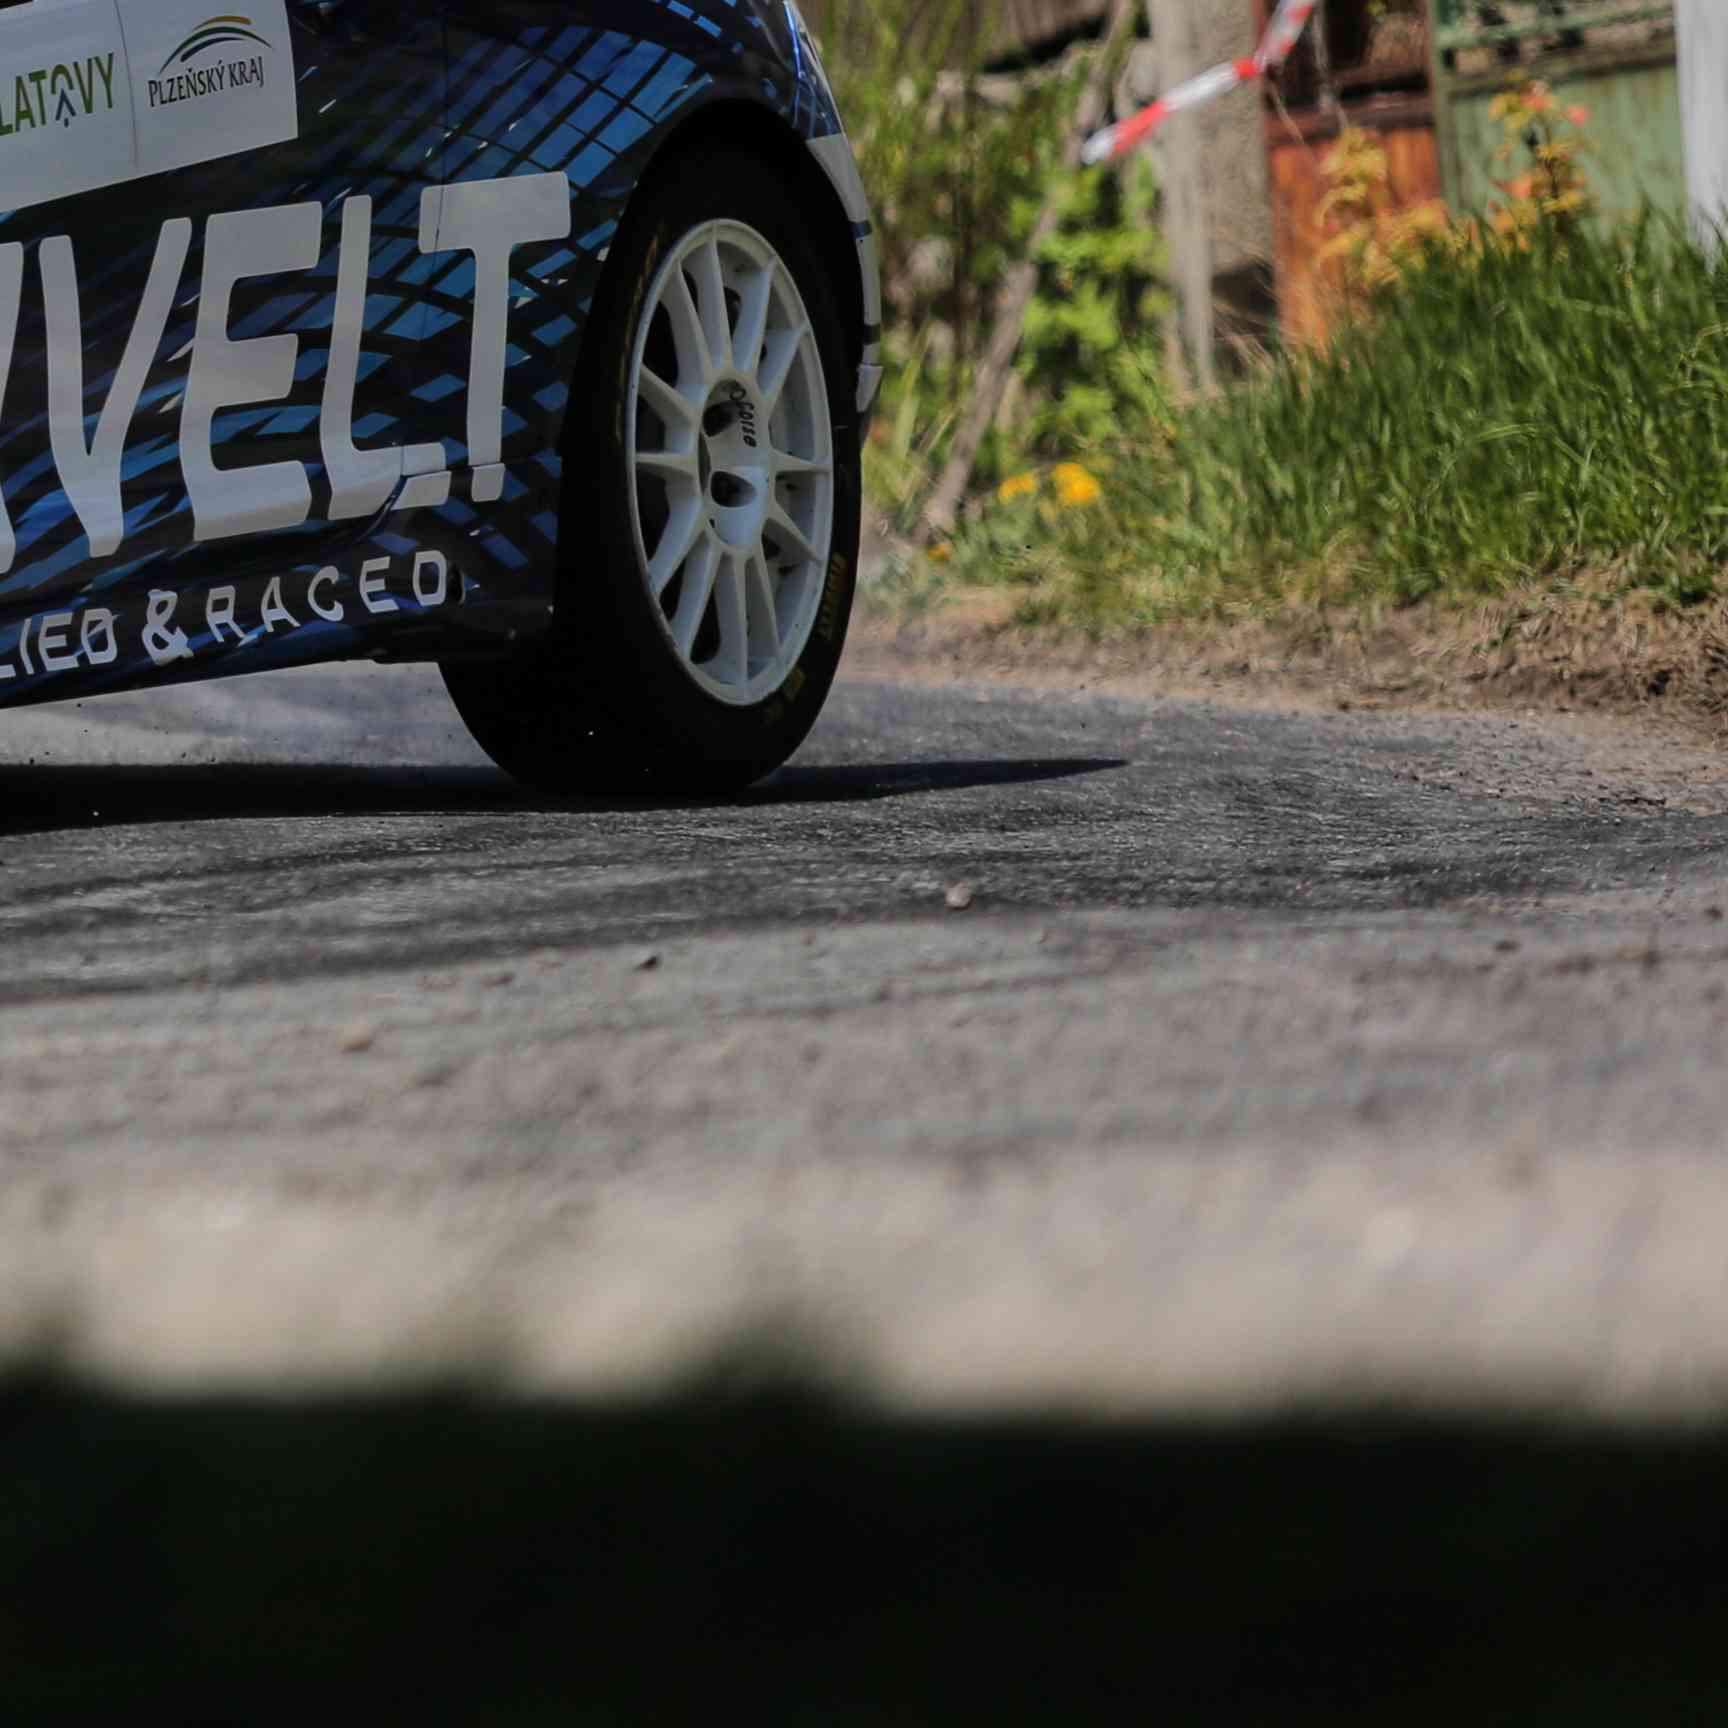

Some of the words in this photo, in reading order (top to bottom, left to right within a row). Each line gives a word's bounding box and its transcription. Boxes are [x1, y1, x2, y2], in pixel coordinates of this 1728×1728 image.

[148, 61, 226, 107] PLZEŇSKÝ
[229, 56, 264, 89] KRAJ
[142, 589, 194, 664] &
